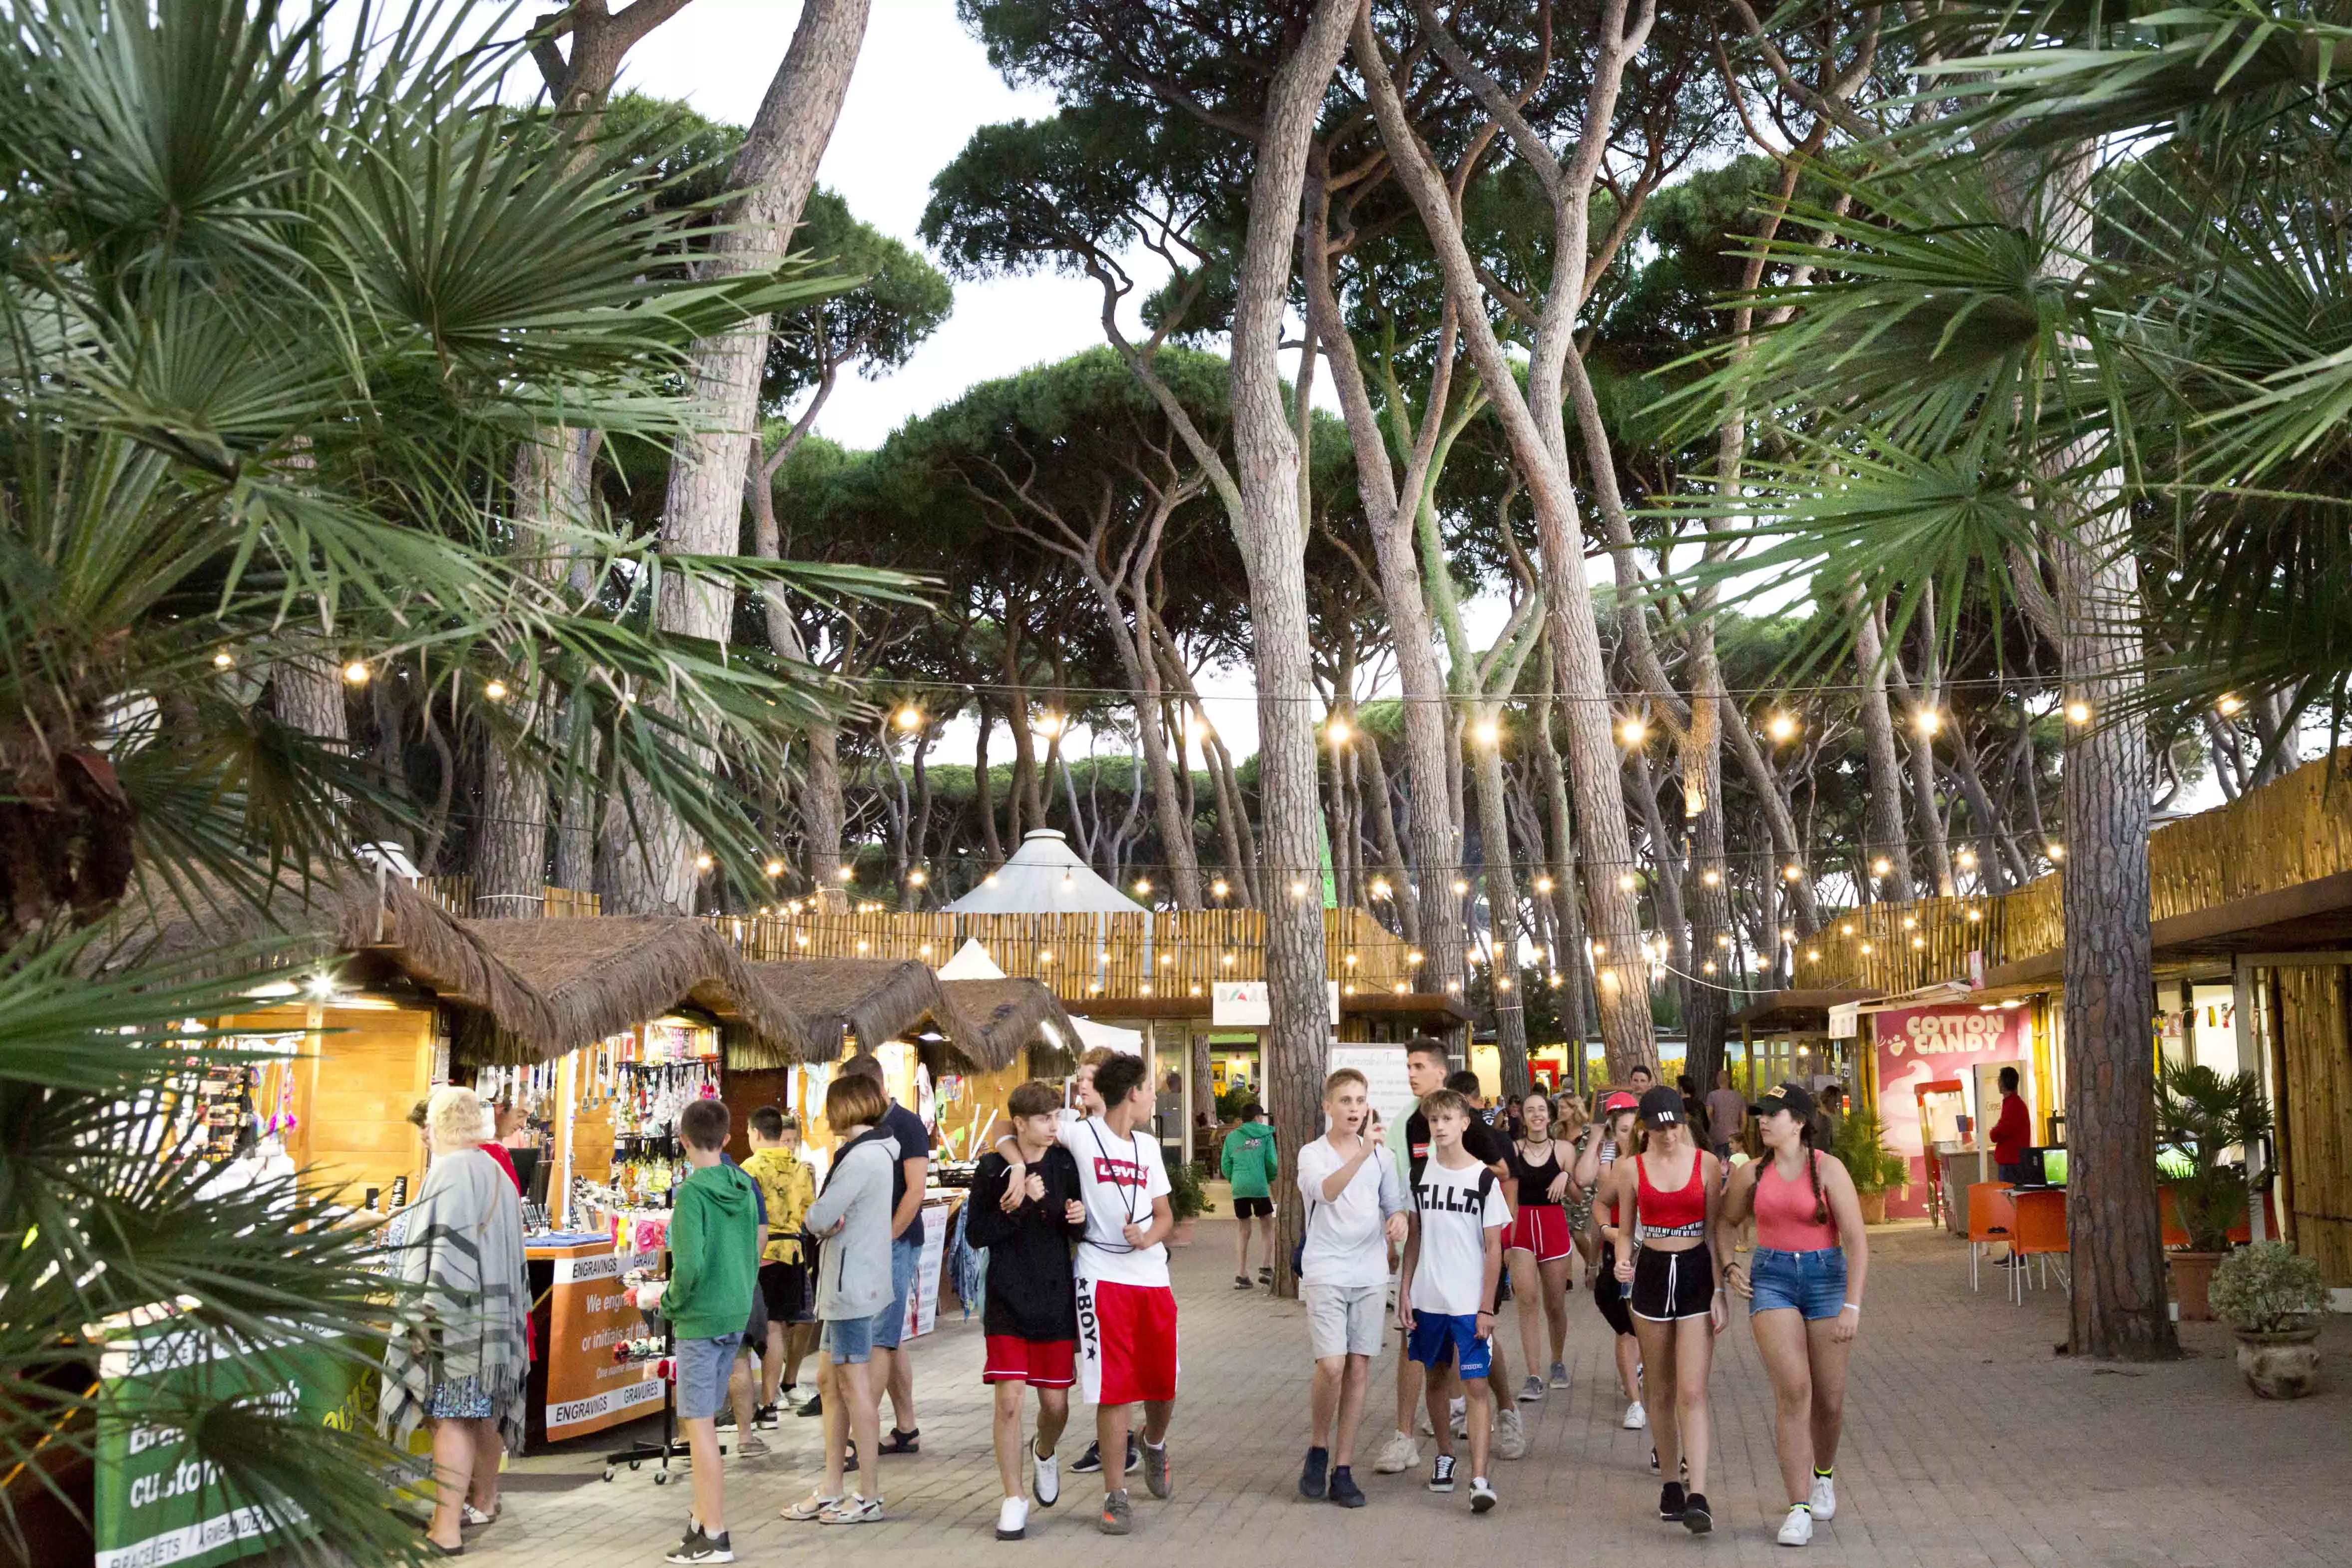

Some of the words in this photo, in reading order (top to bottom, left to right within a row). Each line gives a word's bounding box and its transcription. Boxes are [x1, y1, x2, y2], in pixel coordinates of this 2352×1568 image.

[1906, 1015, 2005, 1037] COTTON
[1914, 1032, 2001, 1054] CANDY
[1099, 1164, 1145, 1180] Levis
[573, 1257, 617, 1278] ENGRAVINGS
[586, 1293, 602, 1313] We
[603, 1293, 628, 1313] engr
[1077, 1294, 1097, 1342] BOY
[582, 1336, 592, 1351] or
[593, 1326, 624, 1348] initials
[636, 1321, 649, 1340] the
[556, 1396, 608, 1422] ENGRAVINGS
[624, 1381, 658, 1404] GRAVURES
